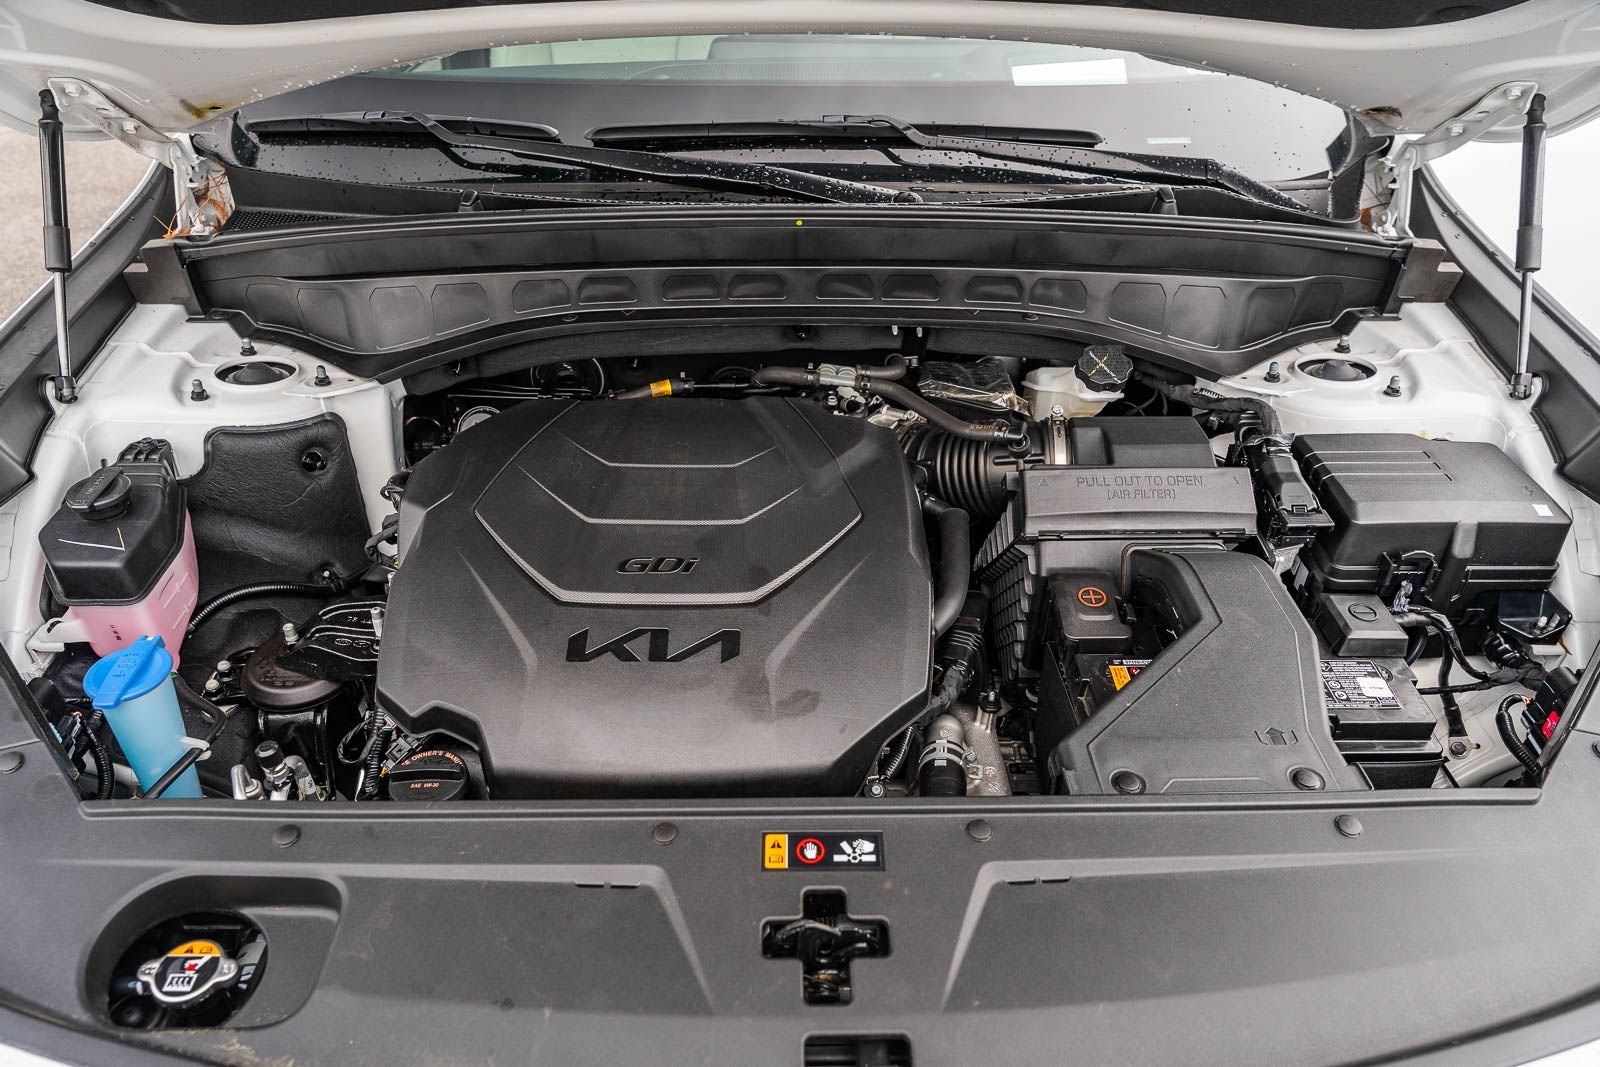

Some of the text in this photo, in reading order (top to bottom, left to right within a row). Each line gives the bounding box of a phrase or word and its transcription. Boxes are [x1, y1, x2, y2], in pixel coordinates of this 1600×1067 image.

[1076, 475, 1203, 488] PULL OUT TO OPEN
[616, 556, 700, 575] GDi
[565, 626, 741, 663] KIA
[411, 750, 443, 761] OWNER'S
